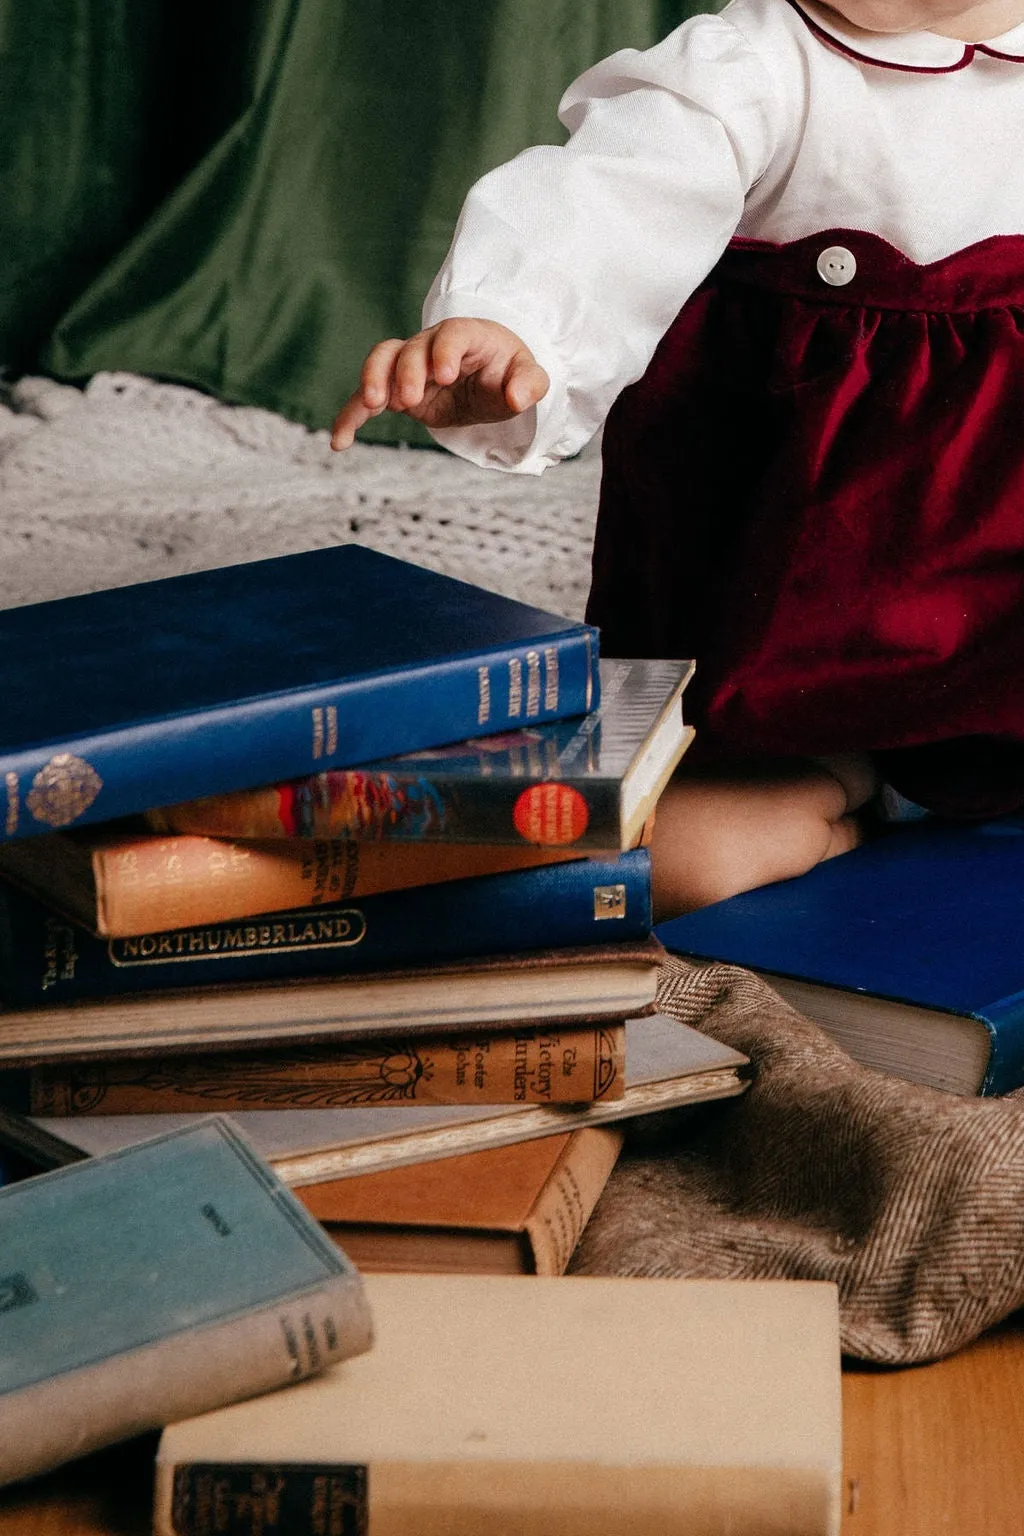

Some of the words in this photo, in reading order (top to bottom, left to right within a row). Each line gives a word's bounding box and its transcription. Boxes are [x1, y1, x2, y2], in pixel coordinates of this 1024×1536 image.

[123, 917, 351, 957] NORTHUMBERLAND
[455, 1043, 470, 1086] Johns
[474, 1040, 490, 1089] Foster
[562, 1047, 577, 1077] The
